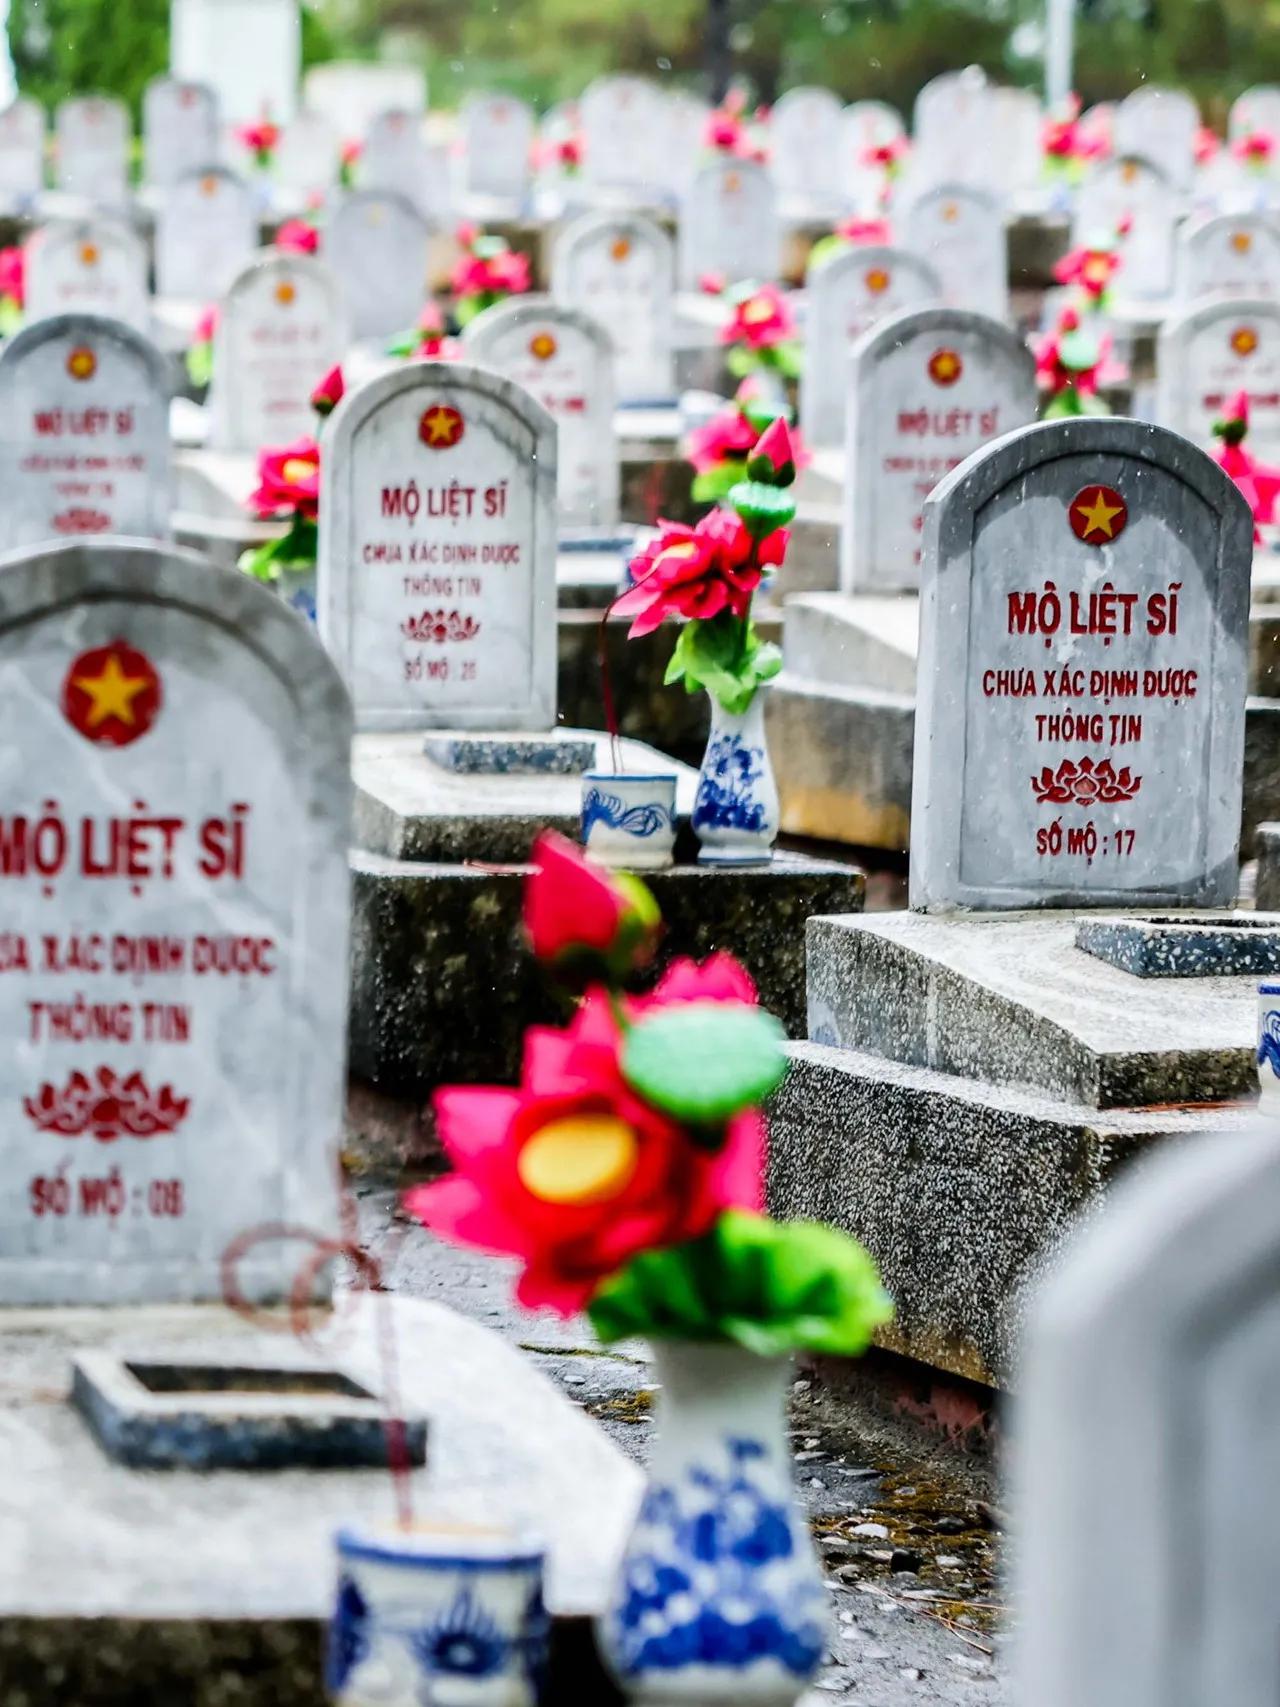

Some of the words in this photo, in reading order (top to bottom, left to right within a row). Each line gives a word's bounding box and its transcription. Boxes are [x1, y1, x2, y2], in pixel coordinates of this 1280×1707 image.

[381, 478, 420, 527] MỘ
[427, 478, 476, 526] LIỆT
[483, 478, 509, 518] SĨ
[457, 577, 482, 597] TIN
[1007, 580, 1061, 648] MỘ
[1070, 581, 1139, 646] LIỆT
[1146, 581, 1182, 636] SĨ
[982, 667, 1037, 698] CHƯA
[1042, 662, 1085, 698] XÁC
[1089, 669, 1139, 706] ĐỊNH
[1143, 667, 1198, 706] ĐƯỢC
[1035, 706, 1104, 743] THÔNG
[1109, 714, 1143, 746] TIN
[80, 798, 186, 898] LIỆT
[197, 802, 252, 880] SĨ
[1036, 815, 1063, 856] SỐ
[1067, 820, 1098, 866] MỘ
[1114, 829, 1136, 856] 17
[27, 990, 133, 1045] THÔNG
[141, 1000, 193, 1044] TIN
